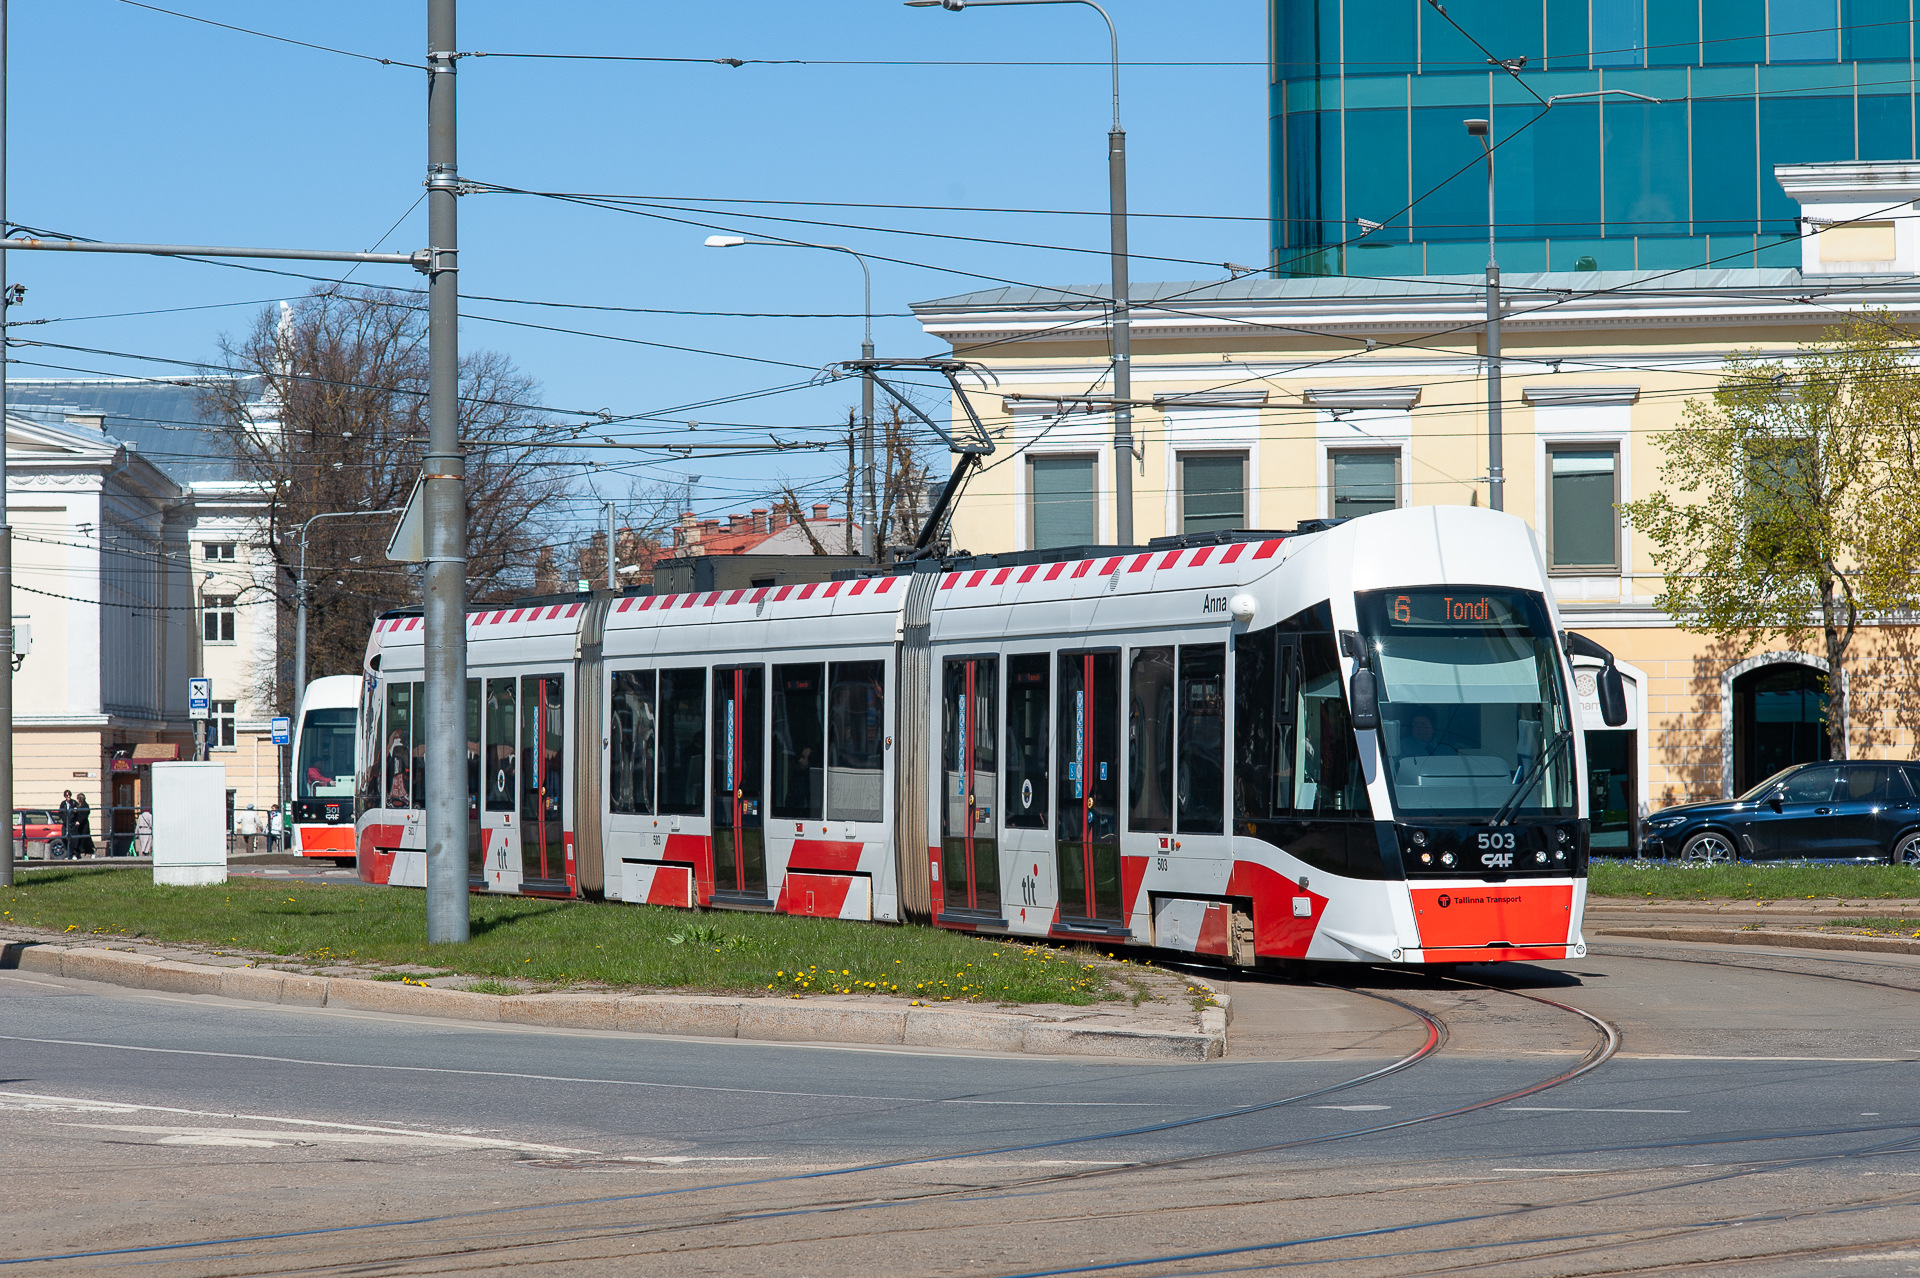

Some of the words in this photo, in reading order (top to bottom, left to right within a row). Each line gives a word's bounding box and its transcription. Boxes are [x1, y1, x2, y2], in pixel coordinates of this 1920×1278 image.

[1203, 593, 1227, 613] Anna
[1394, 595, 1411, 623] 6
[1444, 597, 1488, 620] Tondi
[1478, 833, 1515, 849] 503
[1157, 858, 1168, 871] 503
[1481, 853, 1514, 868] CAF
[1021, 874, 1037, 906] tlt
[1454, 896, 1485, 904] Tallinna
[1486, 896, 1522, 904] Transport
